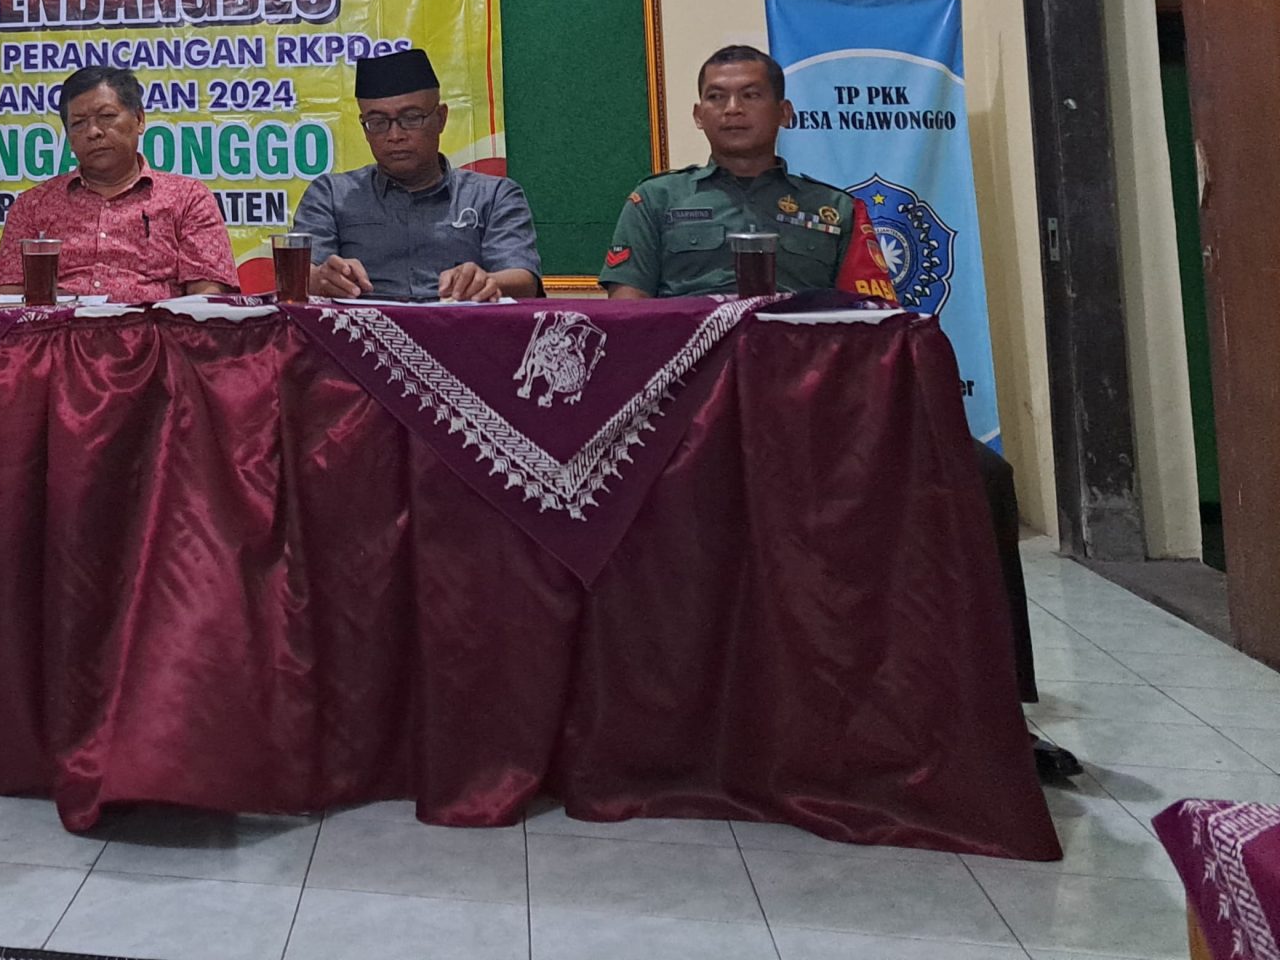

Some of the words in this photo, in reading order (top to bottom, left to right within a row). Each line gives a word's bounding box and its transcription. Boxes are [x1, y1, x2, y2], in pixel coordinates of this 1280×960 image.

[3, 38, 263, 70] PERANCANGAN
[277, 36, 411, 64] RKPDes
[209, 80, 294, 110] 2024
[834, 86, 860, 105] TP
[866, 86, 910, 105] PKK
[787, 111, 832, 129] DESA
[839, 110, 956, 131] NGAWONGGO
